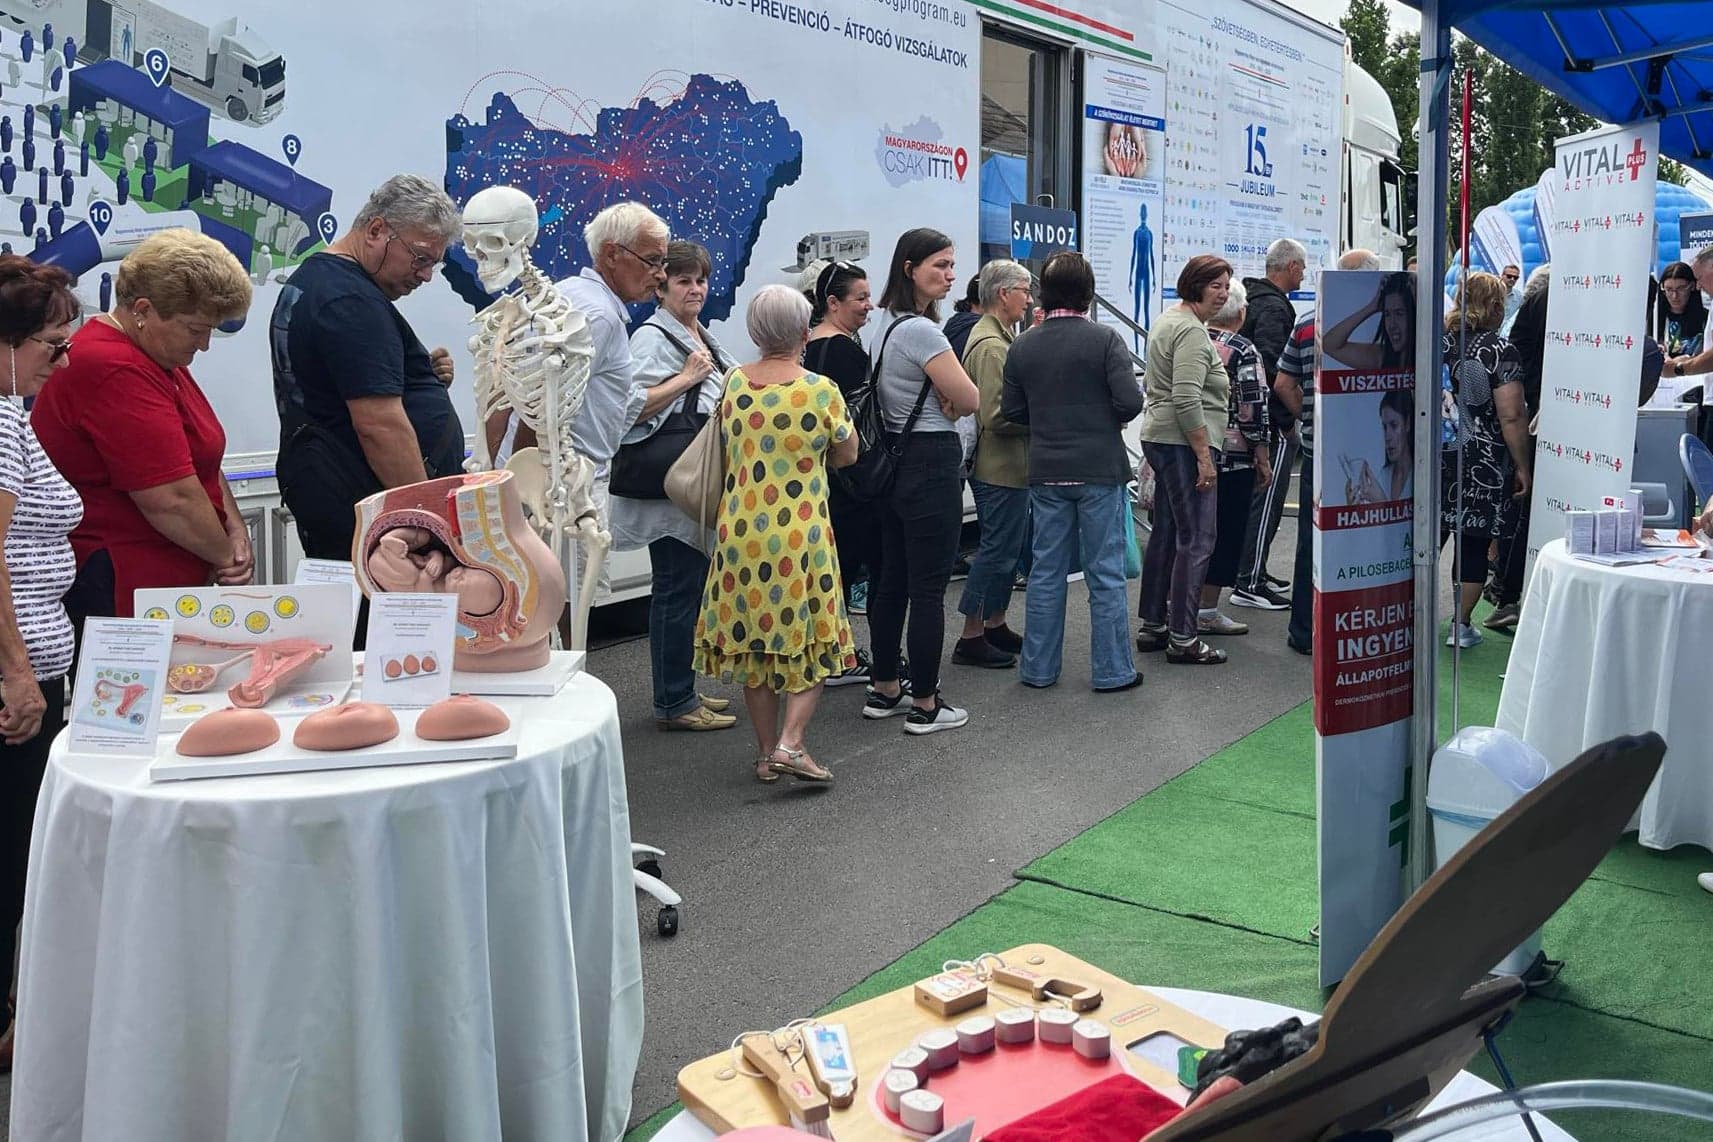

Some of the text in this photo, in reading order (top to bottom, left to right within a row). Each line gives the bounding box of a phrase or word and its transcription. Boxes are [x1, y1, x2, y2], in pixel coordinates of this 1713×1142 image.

[873, 0, 966, 27] gprogram.eu
[750, 0, 830, 32] PREVENCIÓ
[844, 17, 892, 48] ÁTFOGÓ
[895, 36, 967, 68] VIZSGÁLATOK
[151, 55, 163, 71] 6
[286, 139, 297, 155] 8
[885, 136, 953, 157] MAGYARORSZÁGON
[884, 149, 953, 180] CSAK ITT!
[1563, 144, 1646, 179] VITAL PLUS
[1240, 179, 1275, 197] JUBILEUM
[1564, 172, 1625, 192] ACTIVE
[90, 207, 110, 223] 10
[1584, 217, 1604, 228] VITAL
[1614, 213, 1636, 225] VITAL
[323, 218, 334, 233] 3
[1013, 220, 1076, 246] SANDOZ
[1562, 274, 1615, 286] VITAL VITAL
[1574, 333, 1594, 344] VITAL
[1604, 334, 1625, 345] VITAL
[1338, 370, 1414, 391] VISZKETÉS
[1554, 387, 1606, 404] VITAL VITAL
[1565, 446, 1585, 460] VITAL
[1594, 452, 1615, 467] VITAL
[1337, 501, 1413, 526] HAJHULLÁS
[1546, 496, 1567, 512] VITAL
[1528, 545, 1540, 558] VIT
[1336, 567, 1346, 580] A
[1335, 602, 1405, 632] KÉRJEN
[1337, 626, 1413, 660] INGYEN
